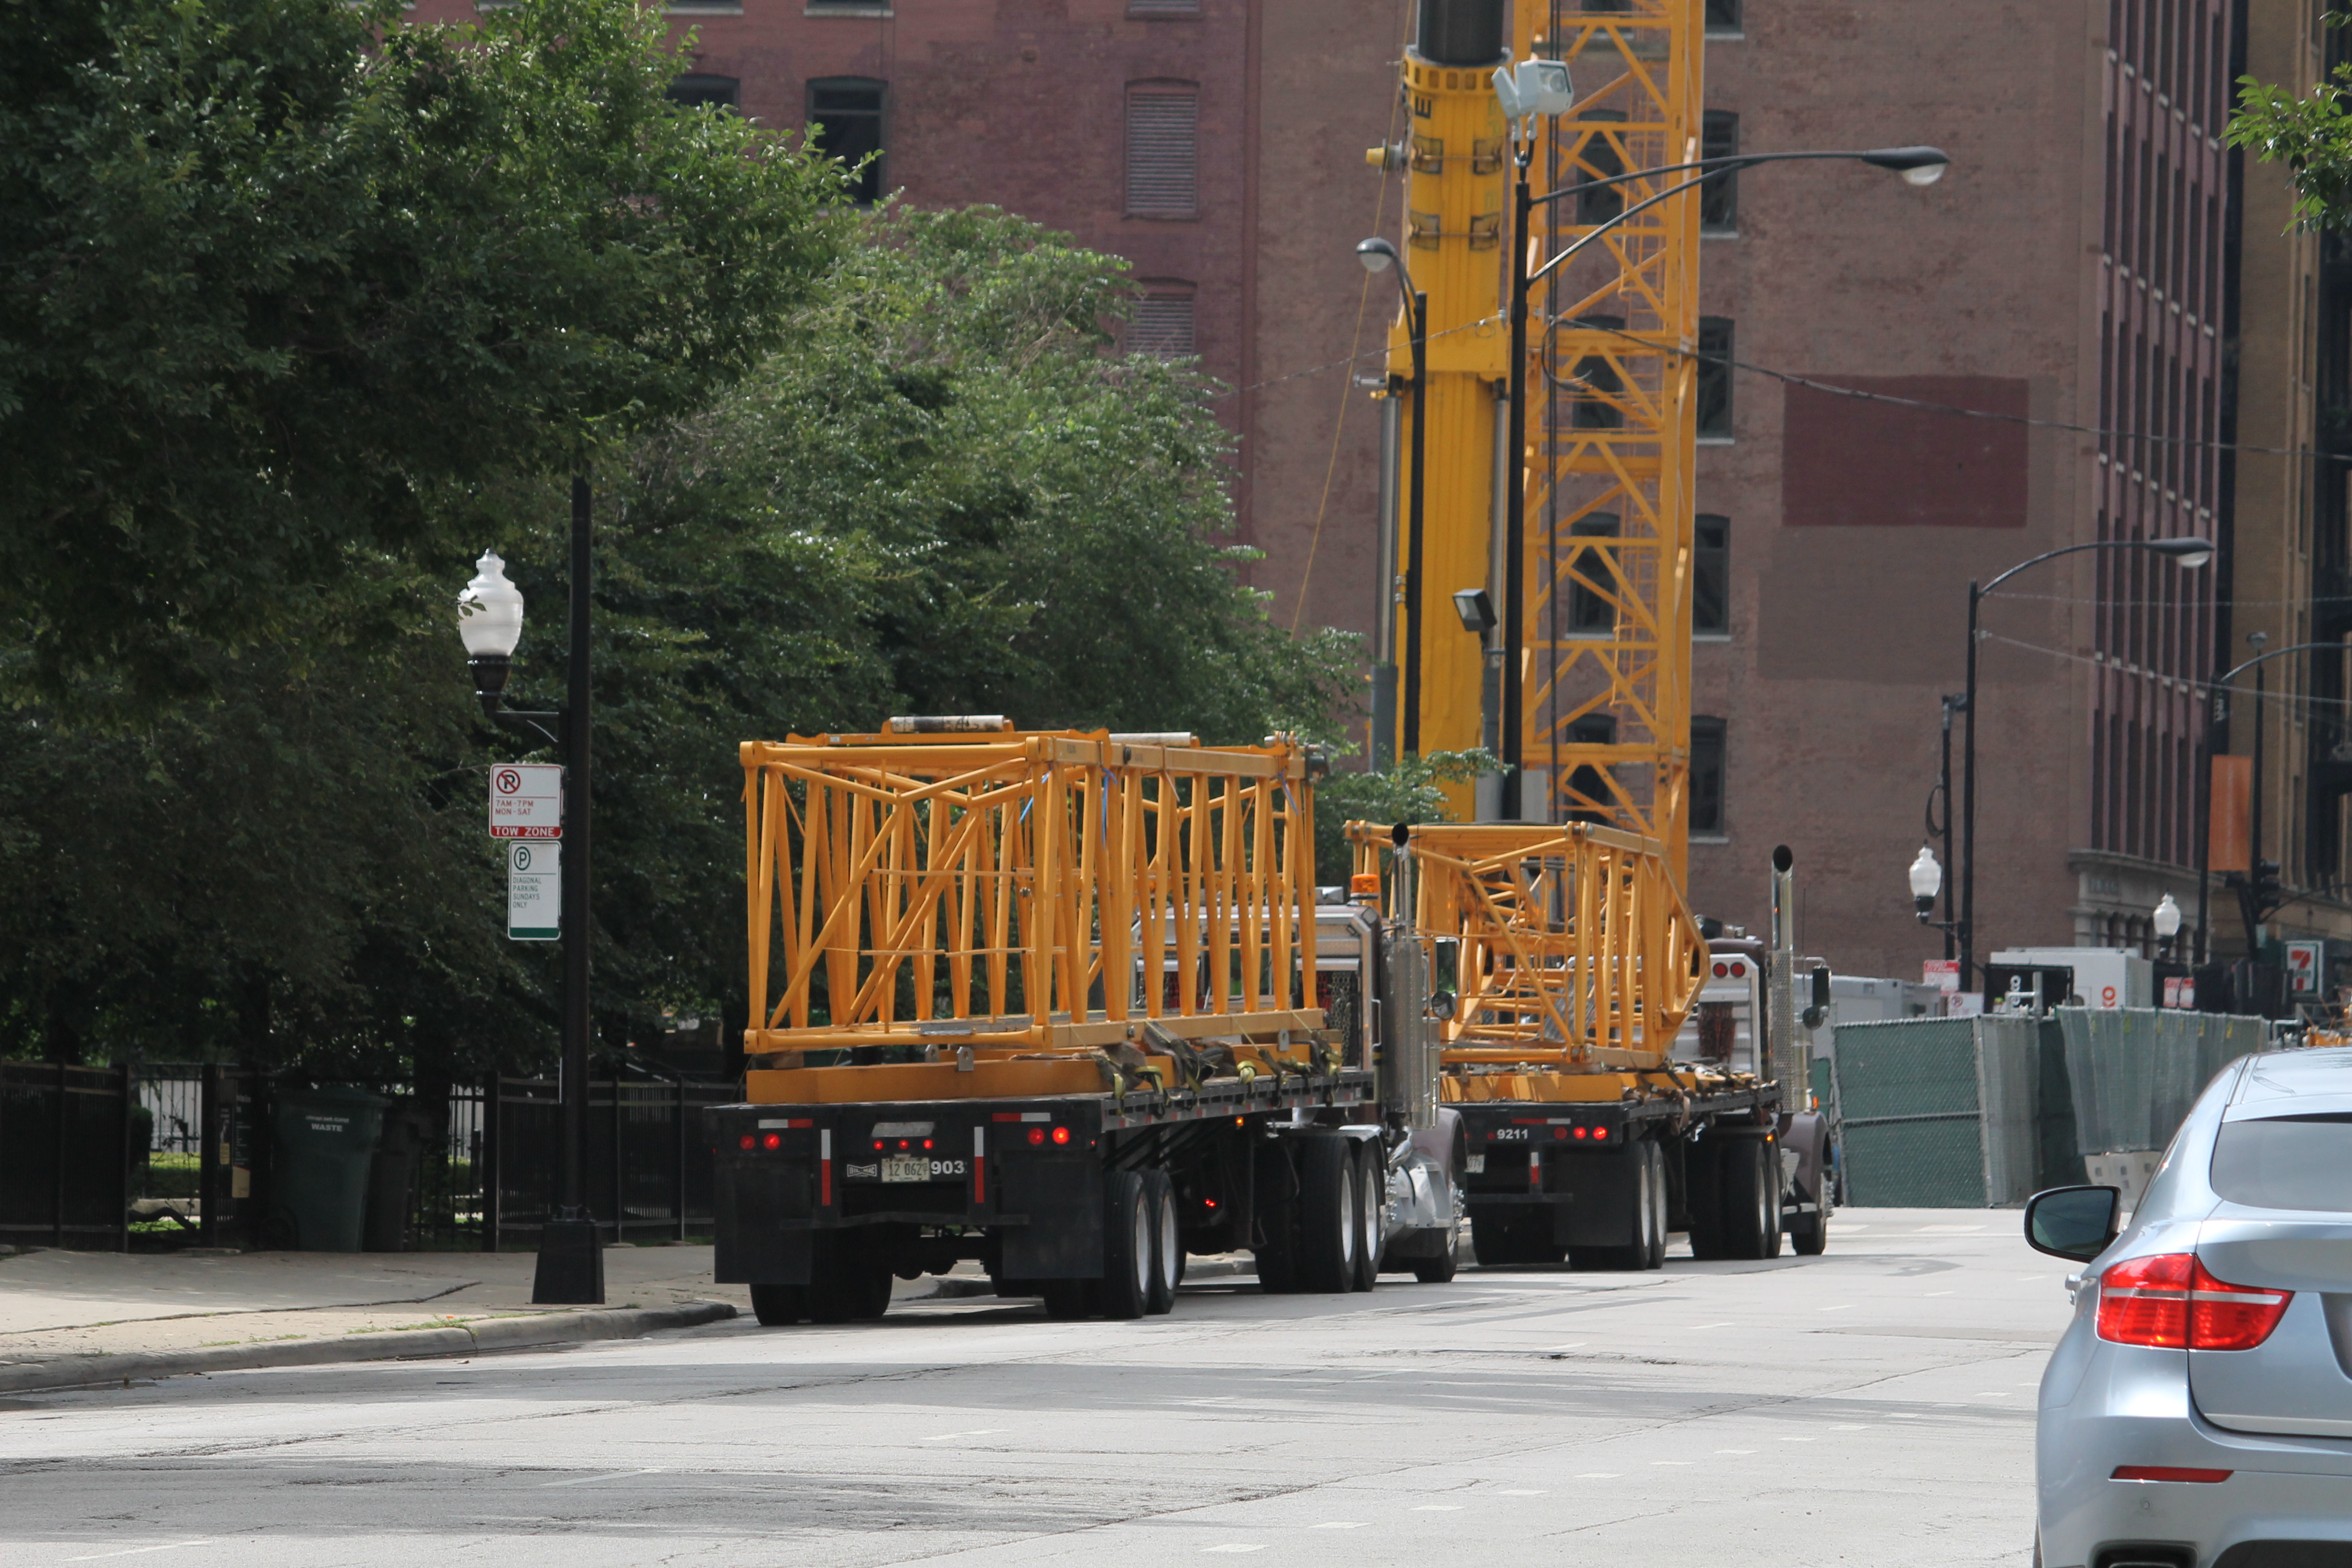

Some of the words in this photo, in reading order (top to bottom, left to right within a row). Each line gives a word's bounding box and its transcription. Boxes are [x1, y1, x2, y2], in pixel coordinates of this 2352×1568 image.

[494, 826, 519, 836] TOW
[524, 827, 555, 836] ZONE
[311, 1123, 343, 1132] WASTE
[1496, 1129, 1528, 1140] 9211
